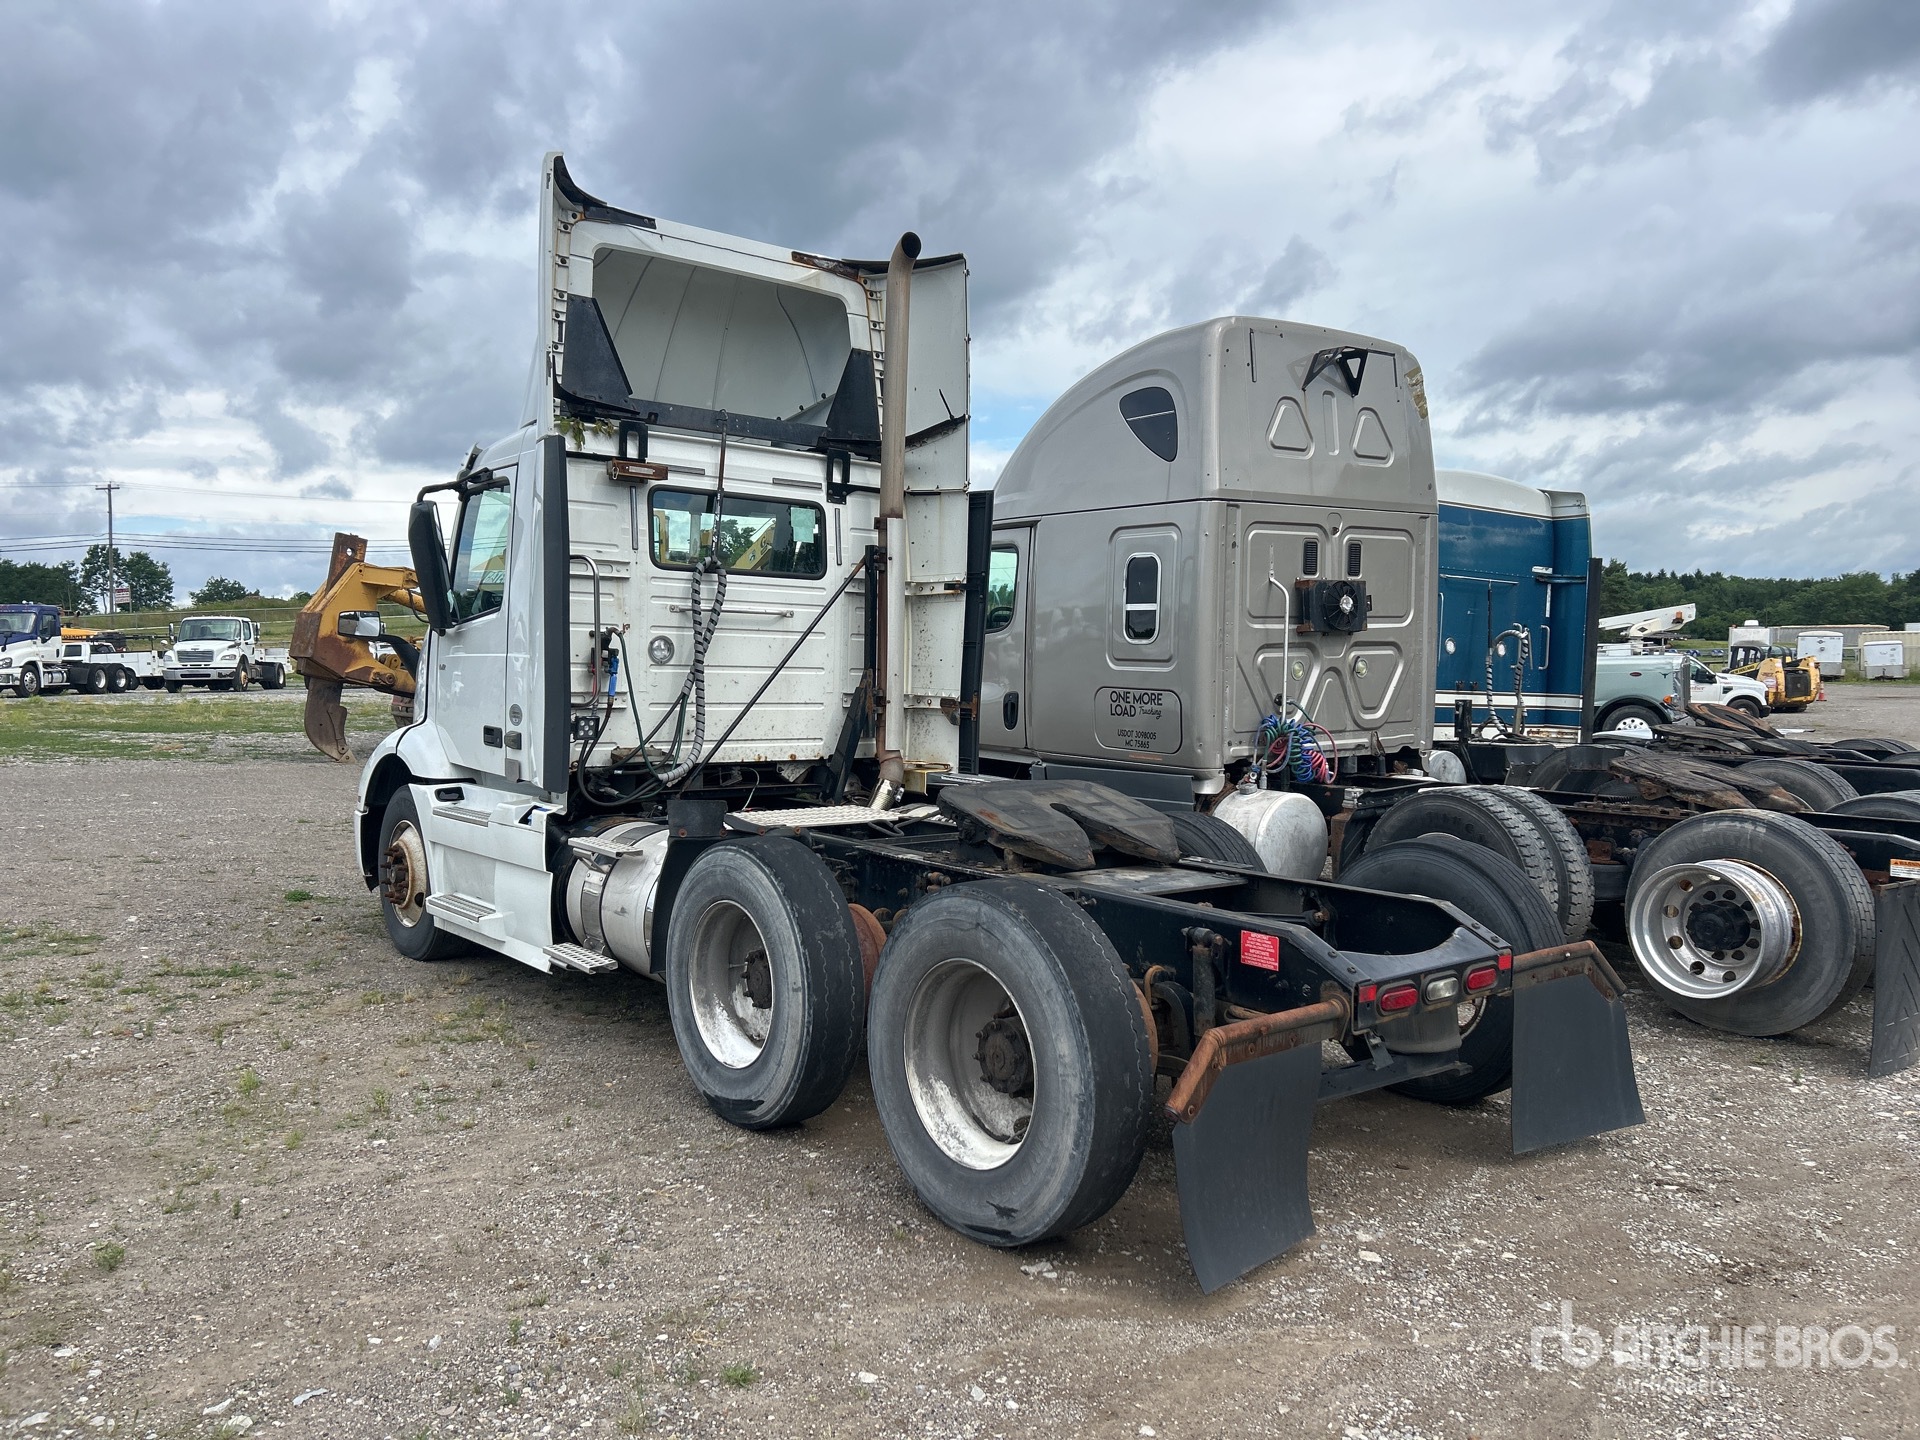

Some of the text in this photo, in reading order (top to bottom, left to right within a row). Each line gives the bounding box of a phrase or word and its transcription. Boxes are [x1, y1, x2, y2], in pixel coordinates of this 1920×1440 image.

[1110, 691, 1163, 706] ONE MORE
[1110, 704, 1162, 720] LOAD Trucking
[1117, 729, 1157, 740] USDOT 3098005
[1134, 740, 1150, 749] 75865
